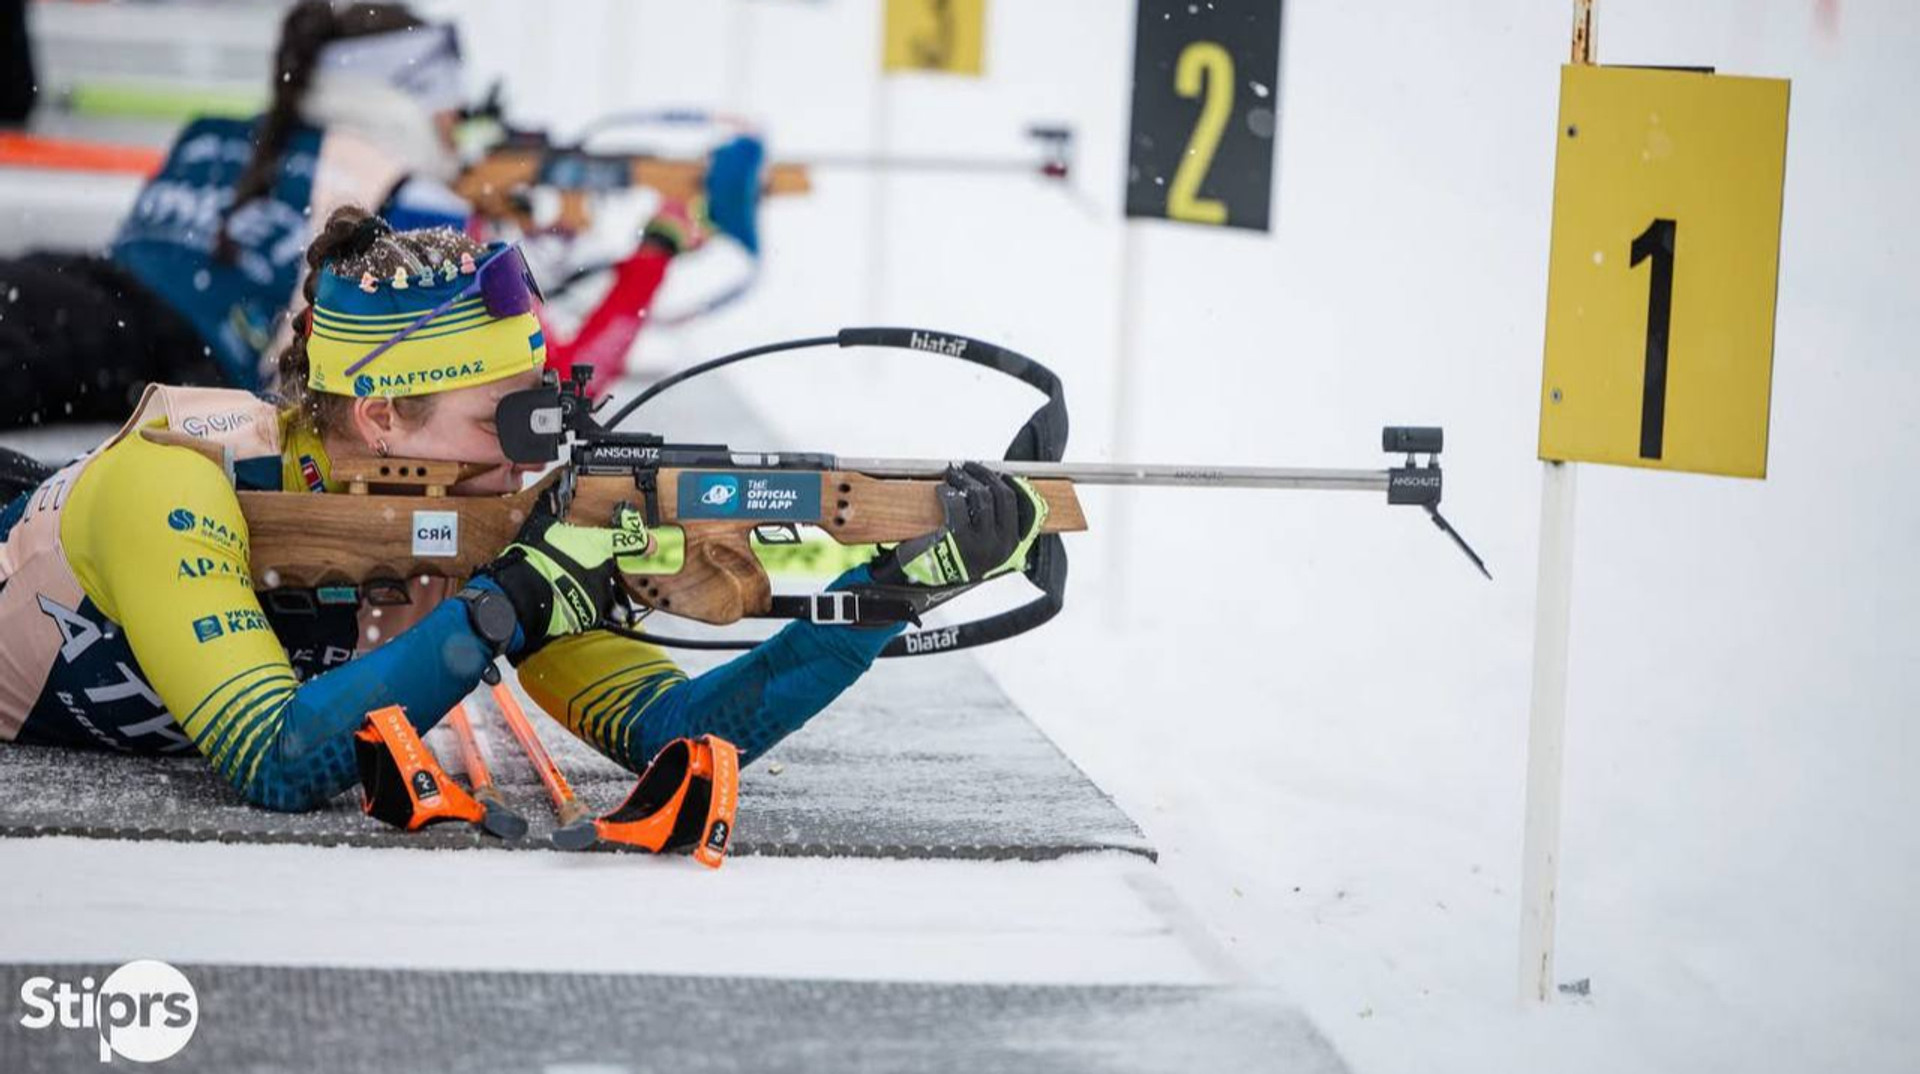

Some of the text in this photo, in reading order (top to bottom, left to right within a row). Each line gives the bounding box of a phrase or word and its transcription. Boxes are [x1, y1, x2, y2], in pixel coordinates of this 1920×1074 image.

[1166, 41, 1235, 225] 2
[1629, 217, 1677, 460] 1
[379, 359, 485, 387] NAFTOGAZ
[594, 447, 660, 459] ANSCHUTZ
[748, 479, 768, 490] THE
[747, 490, 798, 500] OFFICIAL
[747, 500, 793, 510] IBU APP
[417, 525, 452, 540] СЯЙ
